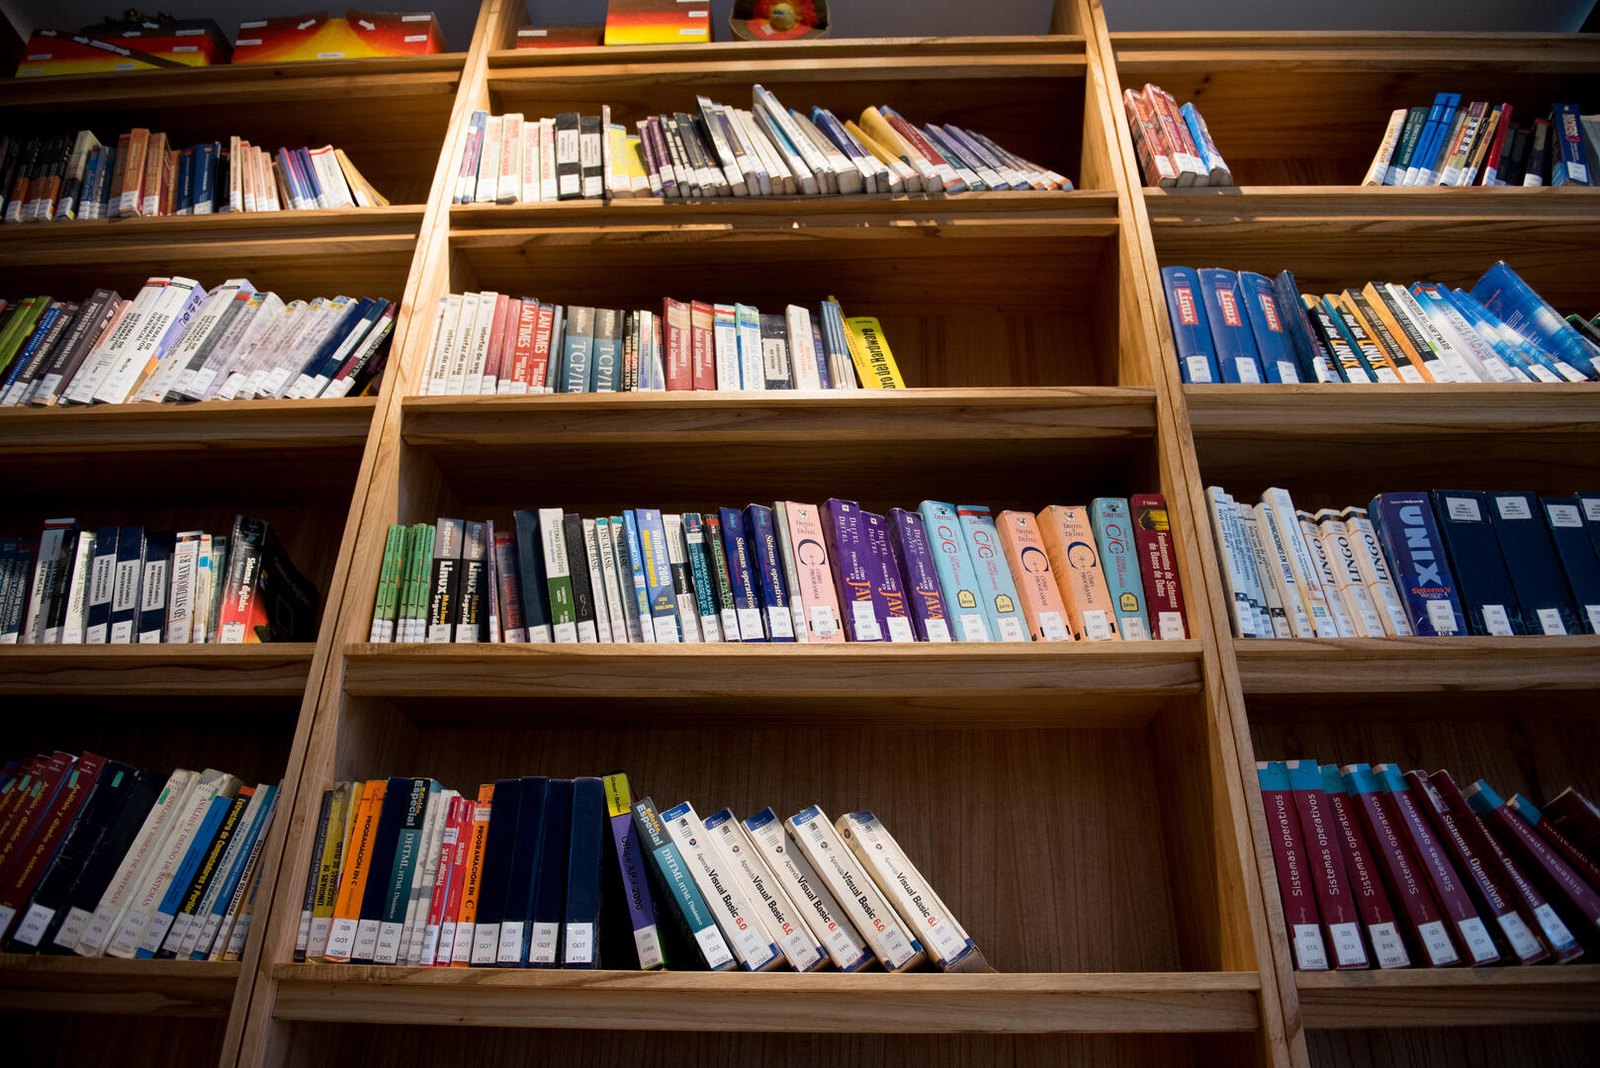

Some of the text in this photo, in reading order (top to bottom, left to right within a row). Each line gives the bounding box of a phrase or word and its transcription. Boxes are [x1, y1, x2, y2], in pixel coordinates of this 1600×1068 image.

[1178, 289, 1195, 323] Linux
[1220, 290, 1238, 324] Linux
[1262, 295, 1279, 330] Linux
[518, 305, 534, 348] LAN TIMES
[535, 312, 552, 354] LAN TIMES
[863, 328, 886, 363] Hardware
[1330, 340, 1362, 369] LINUX
[1357, 340, 1390, 369] LINUX
[568, 343, 586, 393] TCP/IP
[443, 521, 454, 557] Especial
[472, 524, 482, 558] Especial
[587, 529, 595, 552] VISUAL
[615, 526, 624, 549] VISUAL
[839, 516, 849, 543] DEITEL
[850, 517, 859, 544] DEITEL
[869, 528, 878, 555] DEITEL
[878, 530, 888, 556] DEITEL
[914, 529, 925, 555] DEITEL
[1399, 506, 1443, 587] UNIX
[590, 552, 598, 572] BASIC
[601, 527, 613, 570] VISUAL BASIC
[652, 530, 670, 586] Windows 2000
[1314, 538, 1335, 585] LINGO
[1338, 536, 1362, 583] LINGO
[1365, 534, 1388, 581] LINGO
[243, 557, 256, 584] Sistemas
[438, 561, 453, 594] Linux
[468, 562, 482, 594] Linux
[736, 537, 755, 609] Sistemas operativos
[766, 534, 783, 608] Sistemas operativos
[1148, 543, 1165, 598] de Bases de Datos
[1157, 532, 1178, 608] Fundamentos de Sistemas
[175, 582, 189, 608] STUDIO
[696, 570, 703, 581] DE
[701, 601, 708, 611] DE
[878, 587, 905, 618] JAVA
[916, 586, 943, 619] JAVA
[174, 608, 186, 619] 3D
[224, 798, 246, 831] Estructura
[406, 780, 424, 827] Especial
[220, 830, 230, 840] de
[637, 804, 664, 846] Especial
[1402, 793, 1455, 892] Sistemas operativos
[401, 832, 415, 871] DHTML
[1275, 794, 1303, 896] Sistemas operativos
[1308, 794, 1340, 896] Sistemas operativos
[1333, 797, 1375, 896] Sistemas operativos
[1371, 796, 1419, 895] Sistemas operativos
[1443, 814, 1505, 909] Sistemas Operativos
[395, 870, 404, 893] HTML
[465, 825, 484, 909] PROGRAMACION EN C
[622, 836, 643, 911] Office XP 2000
[662, 848, 691, 902] DHTML HTML
[1503, 857, 1539, 908] Operativos
[143, 872, 166, 907] SISTEMAS
[228, 885, 244, 916] PROYECTOS
[317, 874, 329, 906] LENGUAJES
[697, 853, 748, 931] Aprenda Visual Basic 6.0
[752, 875, 773, 903] Visual
[768, 900, 786, 924] Basic
[782, 922, 794, 936] 6.0
[785, 860, 831, 924] Aprenda Visual Basic
[842, 871, 885, 932] Visual Basic 6.0
[896, 872, 931, 918] Visual Basic
[796, 947, 808, 957] HAL
[838, 943, 849, 952] HAL
[891, 942, 902, 951] HAL
